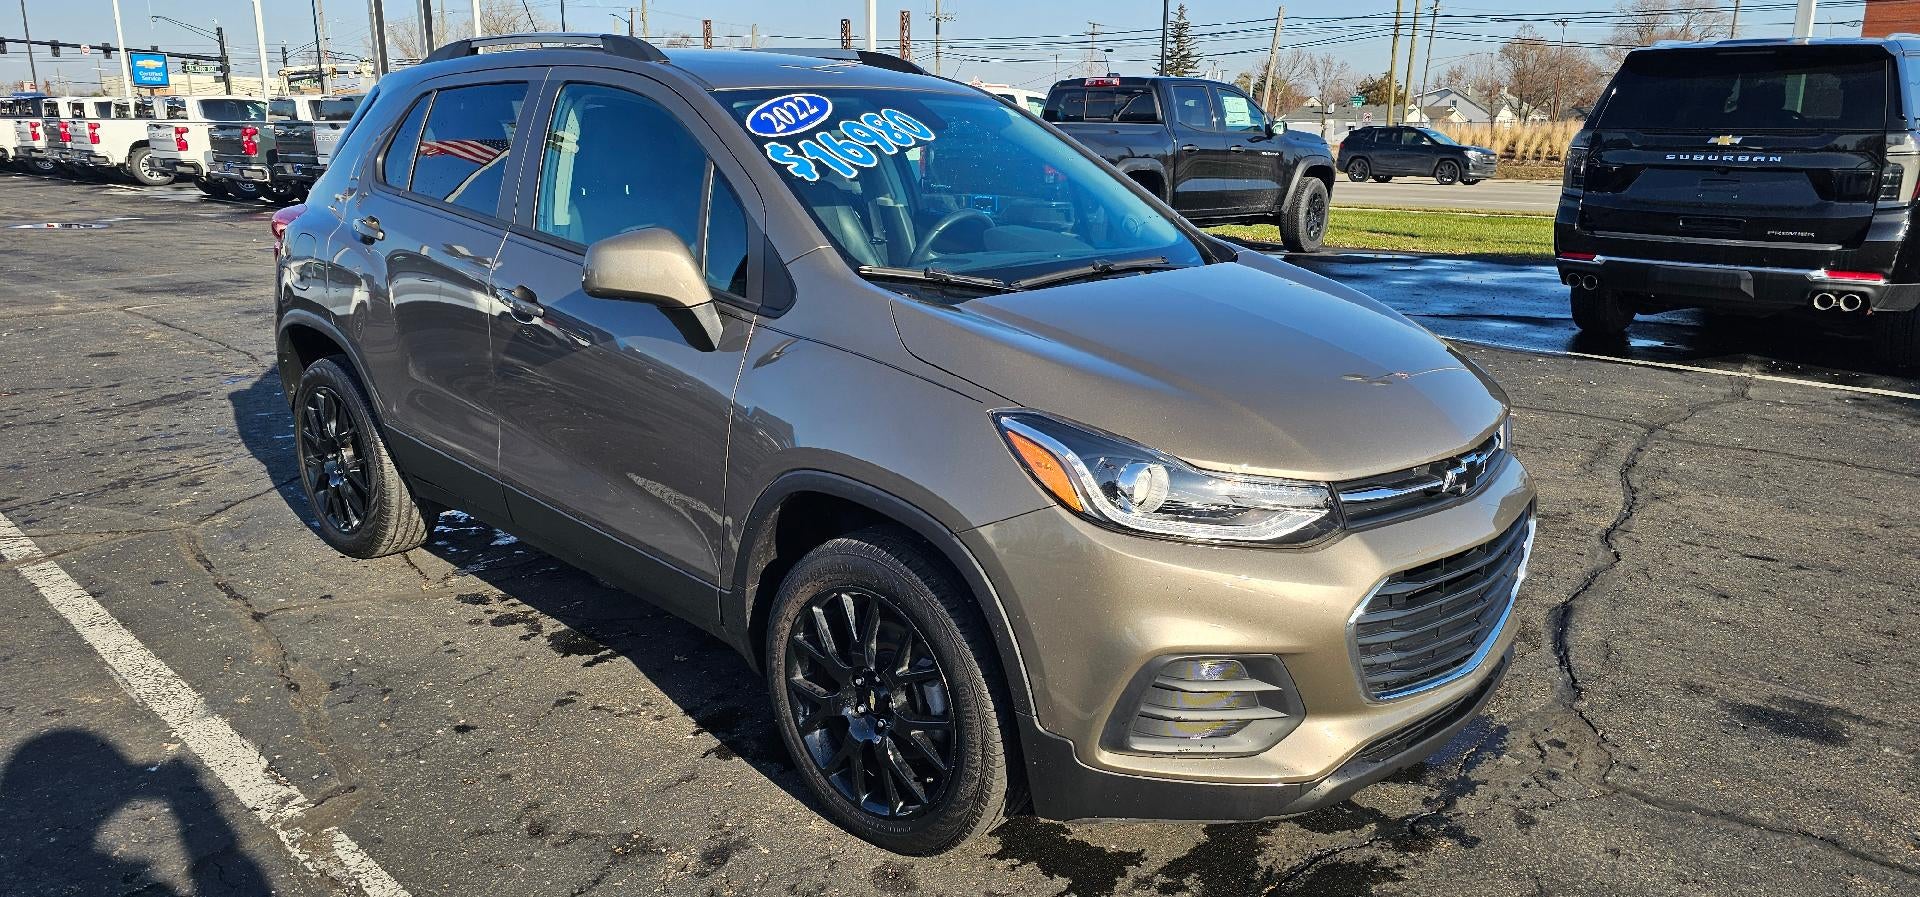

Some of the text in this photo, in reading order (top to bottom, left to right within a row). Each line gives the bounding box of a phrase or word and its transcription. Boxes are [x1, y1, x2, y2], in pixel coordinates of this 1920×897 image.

[760, 96, 820, 132] 2022
[764, 108, 936, 181] $16980
[1665, 154, 1782, 162] SUBURBAN
[1767, 230, 1815, 238] PREMIER
